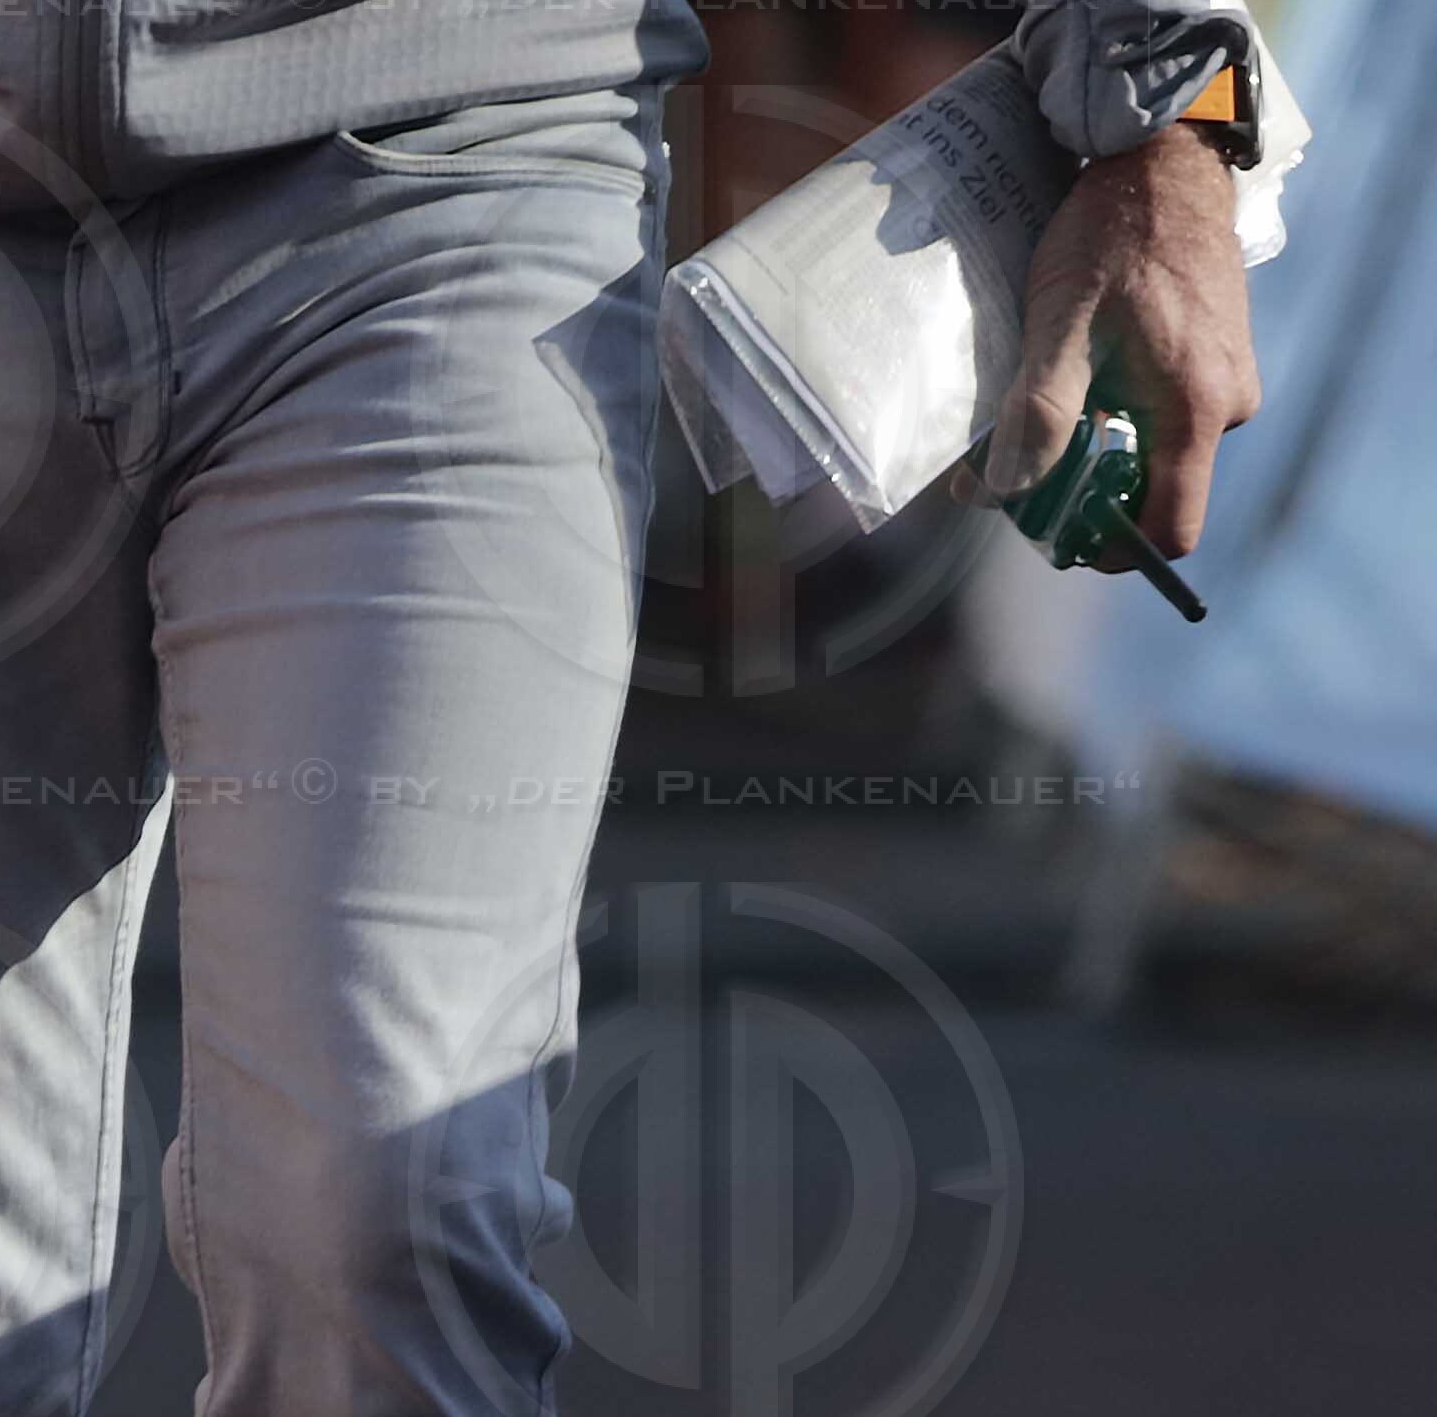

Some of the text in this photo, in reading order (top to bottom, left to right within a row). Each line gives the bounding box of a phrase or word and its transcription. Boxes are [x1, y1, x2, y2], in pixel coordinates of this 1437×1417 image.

[921, 122, 963, 168] ins
[959, 165, 1006, 224] Ziel
[986, 151, 1050, 243] richti
